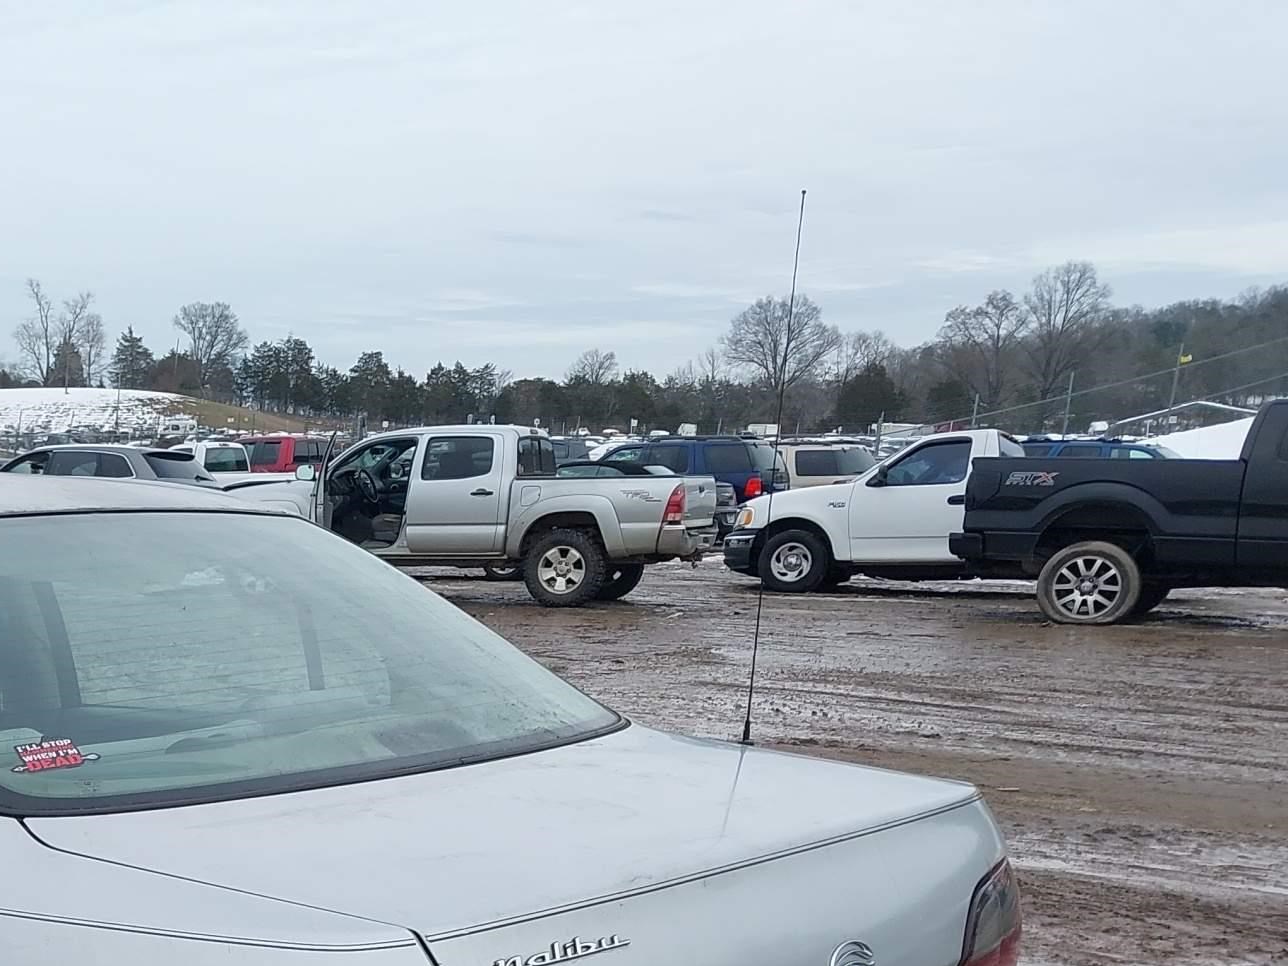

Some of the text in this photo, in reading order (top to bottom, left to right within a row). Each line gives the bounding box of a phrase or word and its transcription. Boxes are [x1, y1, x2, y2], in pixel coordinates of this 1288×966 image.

[15, 743, 41, 753] I'LL
[41, 739, 72, 748] STOP
[22, 751, 57, 762] WHEN
[57, 748, 79, 756] I'M
[26, 754, 83, 771] DEAD
